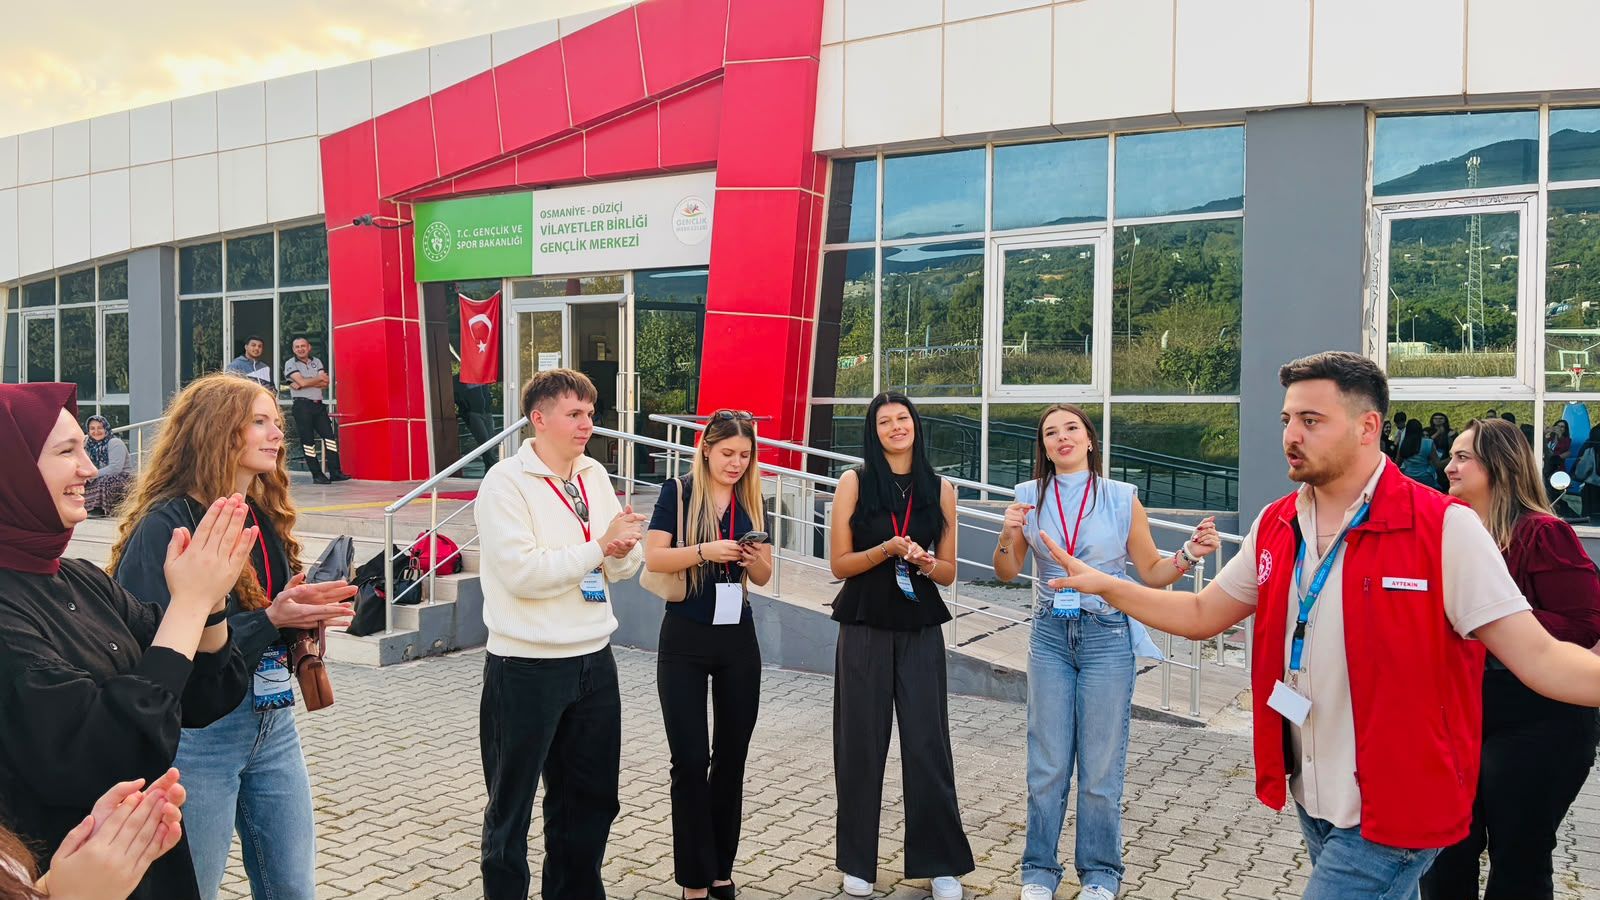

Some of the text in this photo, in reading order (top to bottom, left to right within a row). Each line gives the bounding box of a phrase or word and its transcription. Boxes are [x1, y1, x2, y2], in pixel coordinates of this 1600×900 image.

[540, 205, 585, 219] OSMANİYE
[592, 201, 623, 215] DÜZİÇİ
[457, 229, 471, 238] T.C.
[511, 224, 523, 233] VE
[540, 214, 648, 236] VİLAYETLER BİRLİĞİ
[456, 235, 523, 250] SPOR BAKANLIĞI
[540, 232, 640, 255] GENÇLİK MERKEZİ
